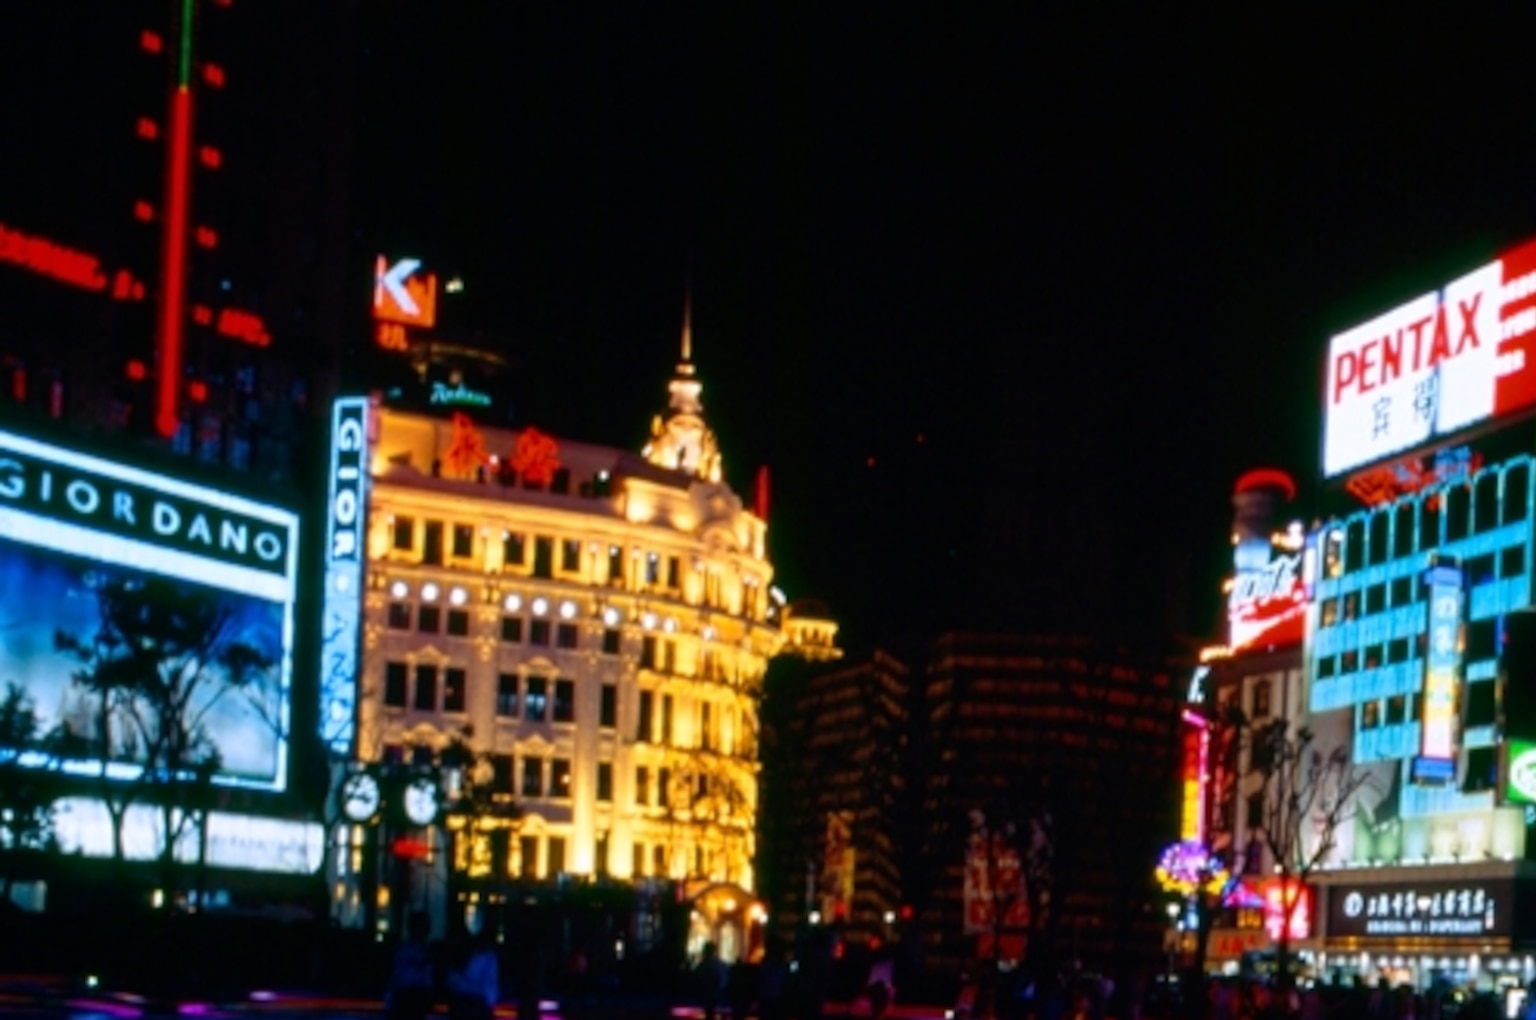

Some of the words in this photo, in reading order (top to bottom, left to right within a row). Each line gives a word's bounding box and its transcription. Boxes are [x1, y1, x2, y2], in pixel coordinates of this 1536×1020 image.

[1333, 291, 1483, 405] PENTAX
[0, 458, 282, 560] GIORDANO
[329, 416, 362, 724] GIORAN
